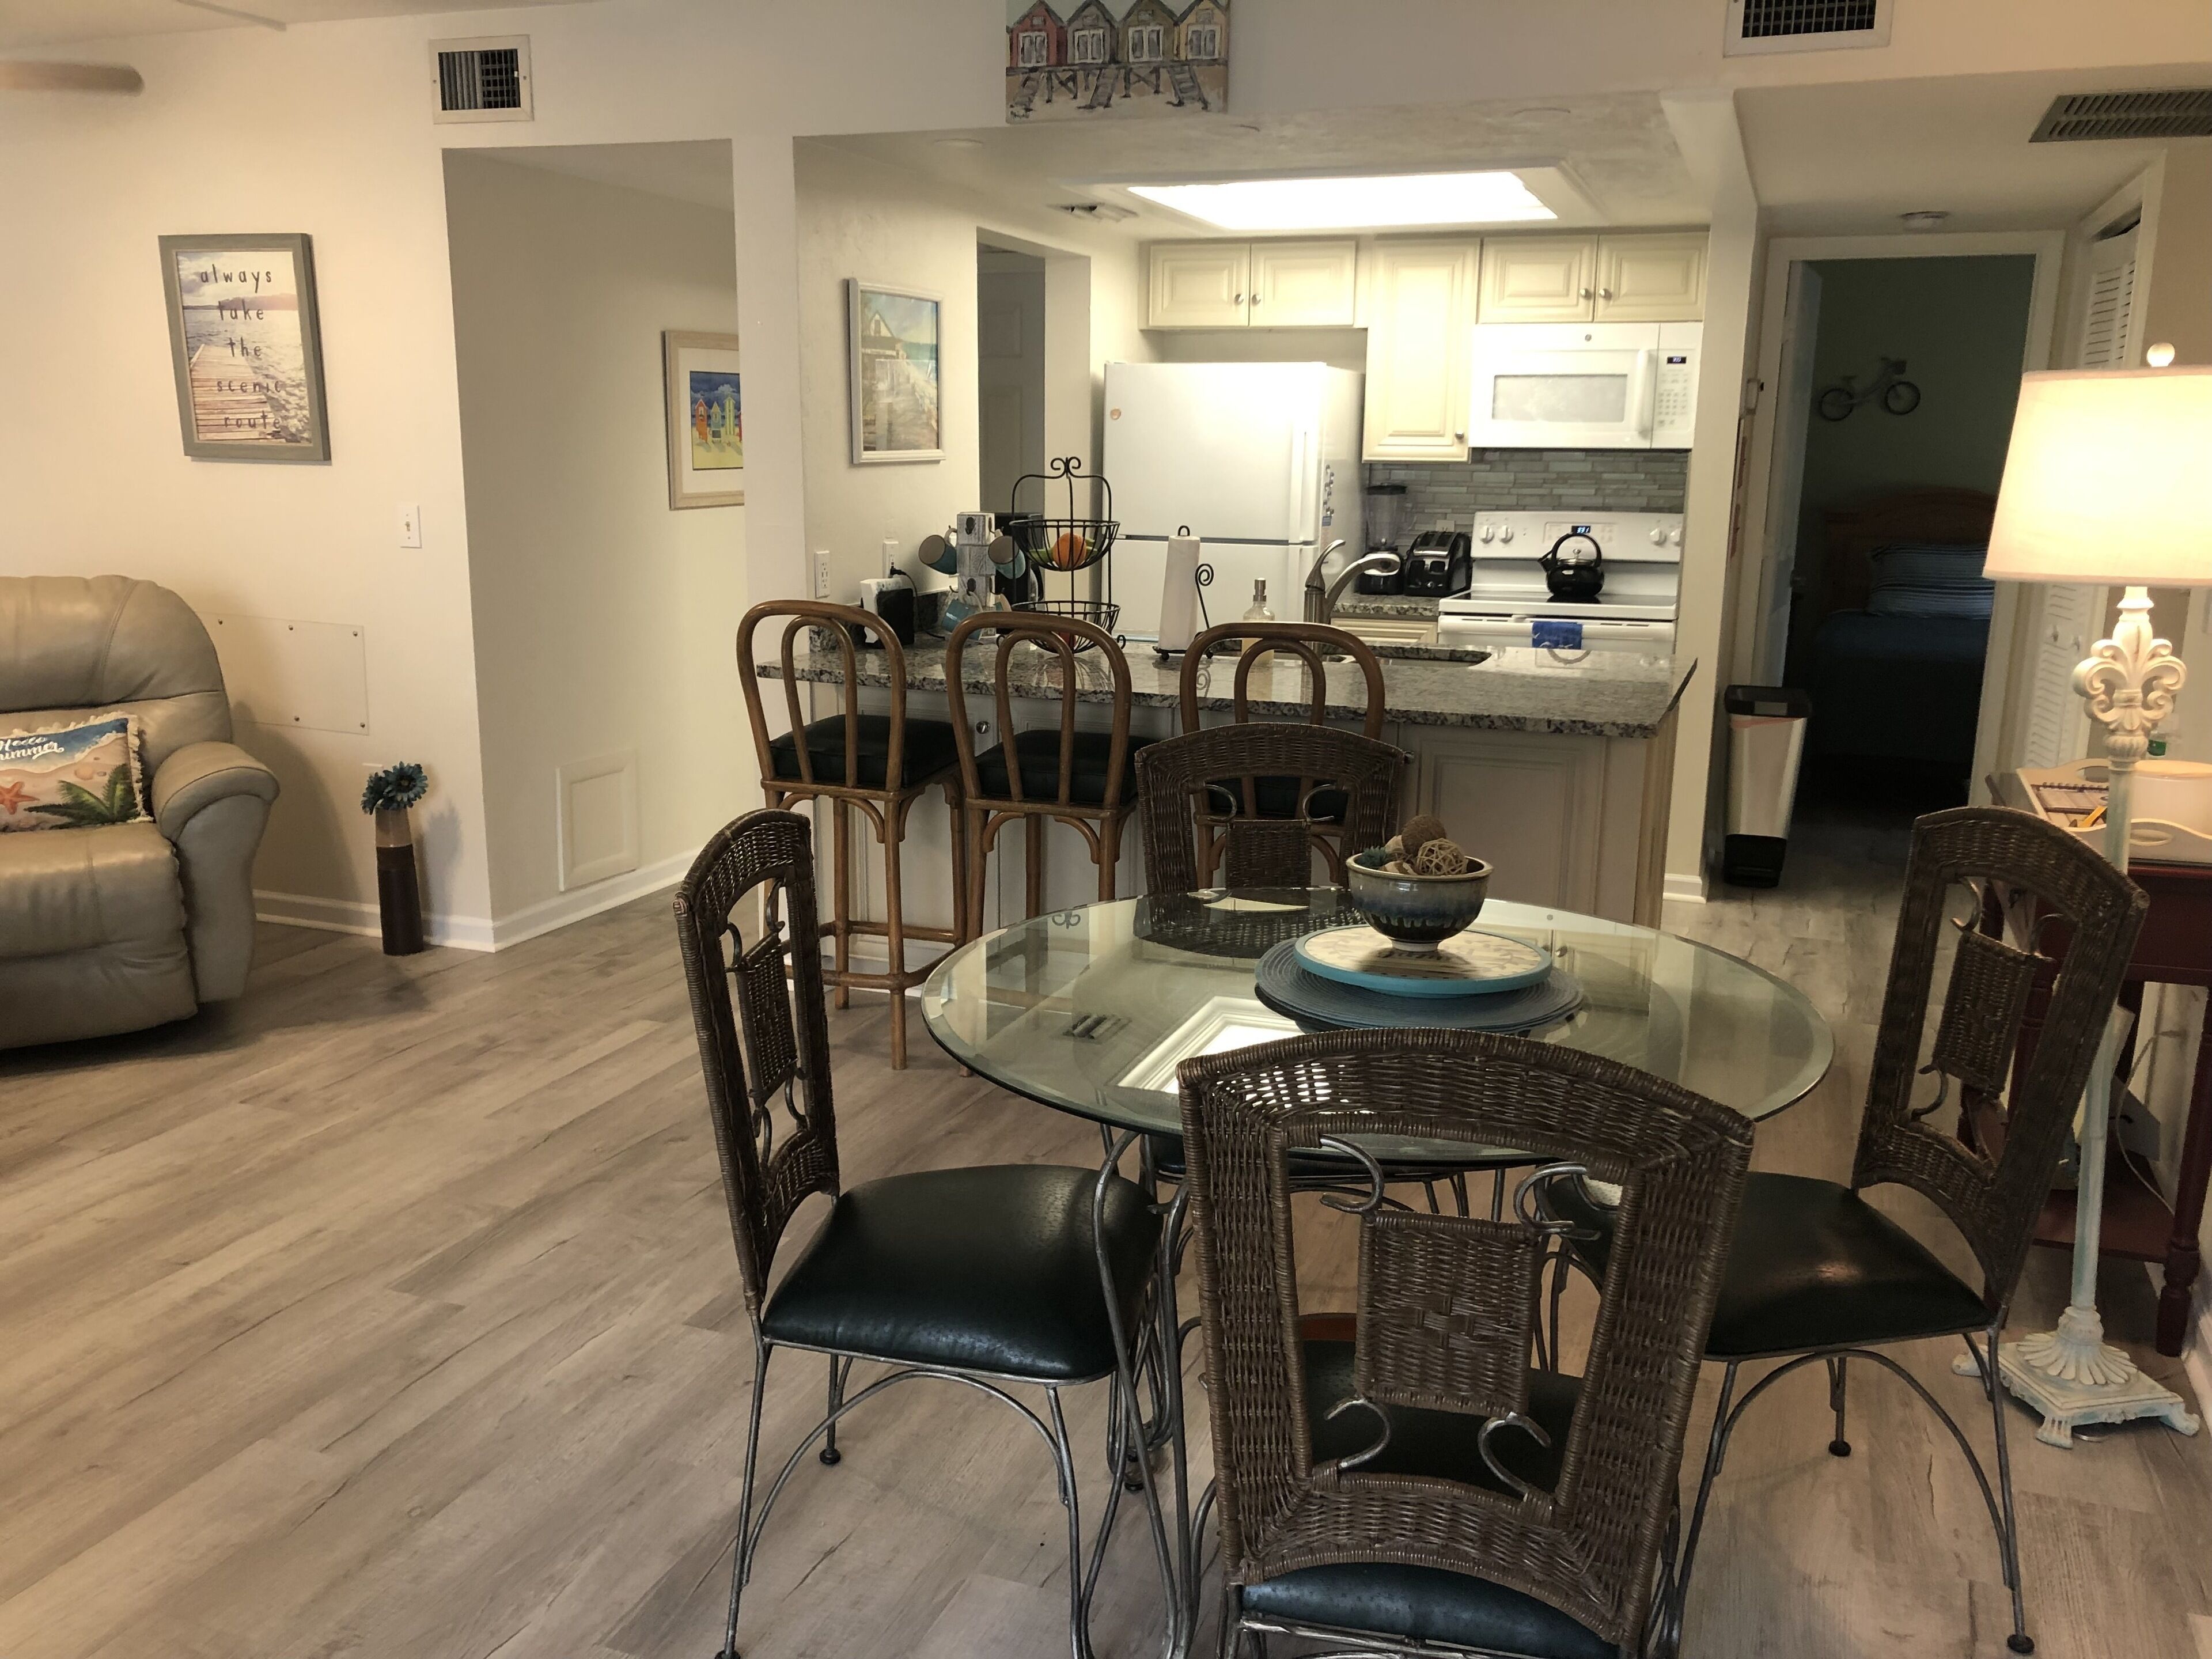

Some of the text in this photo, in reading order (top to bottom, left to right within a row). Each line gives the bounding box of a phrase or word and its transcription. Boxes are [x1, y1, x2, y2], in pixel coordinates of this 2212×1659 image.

[200, 263, 272, 294] always
[217, 298, 264, 321] take
[226, 336, 262, 357] the
[217, 380, 282, 393] scenic
[224, 410, 281, 430] route
[0, 741, 65, 760] ummer
